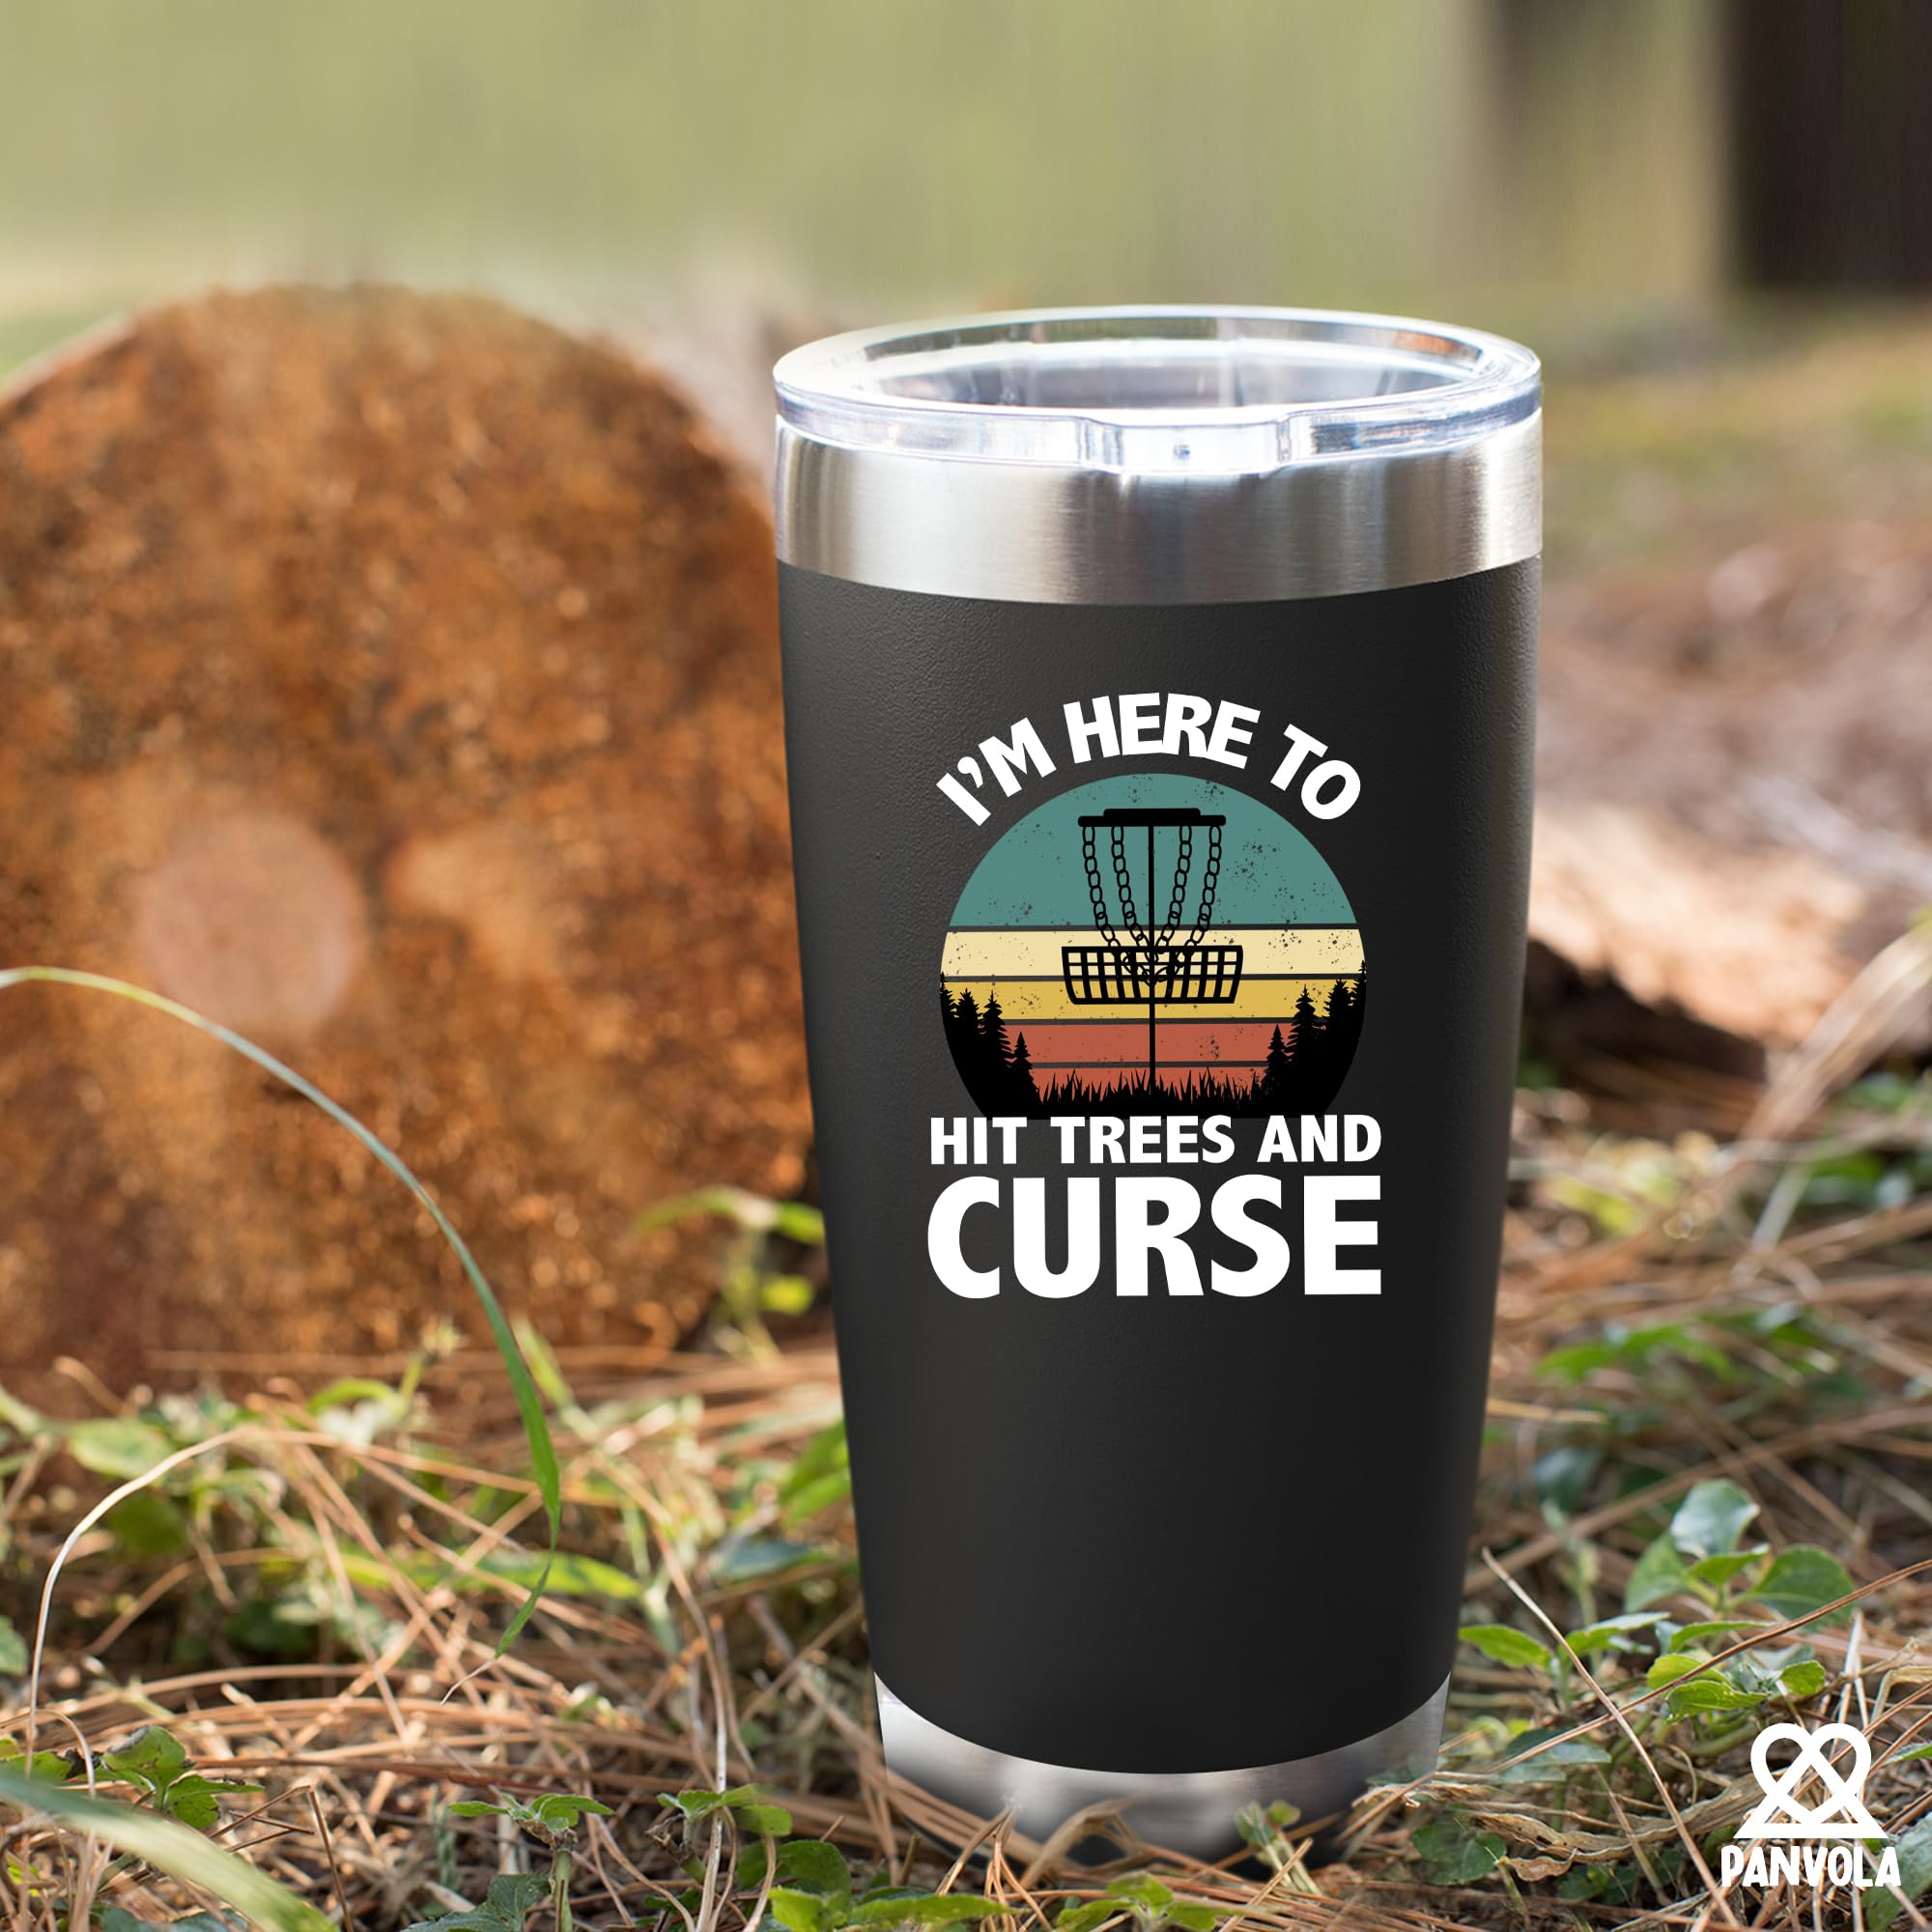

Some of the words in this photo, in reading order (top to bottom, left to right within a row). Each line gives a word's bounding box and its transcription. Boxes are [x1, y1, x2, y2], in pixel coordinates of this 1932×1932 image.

[1063, 692, 1261, 769] HERE
[1270, 724, 1361, 820] TO
[930, 1116, 1028, 1165] HIT
[1050, 1115, 1236, 1164] TREES
[1257, 1114, 1381, 1163] AND
[927, 1174, 1382, 1299] CURSE
